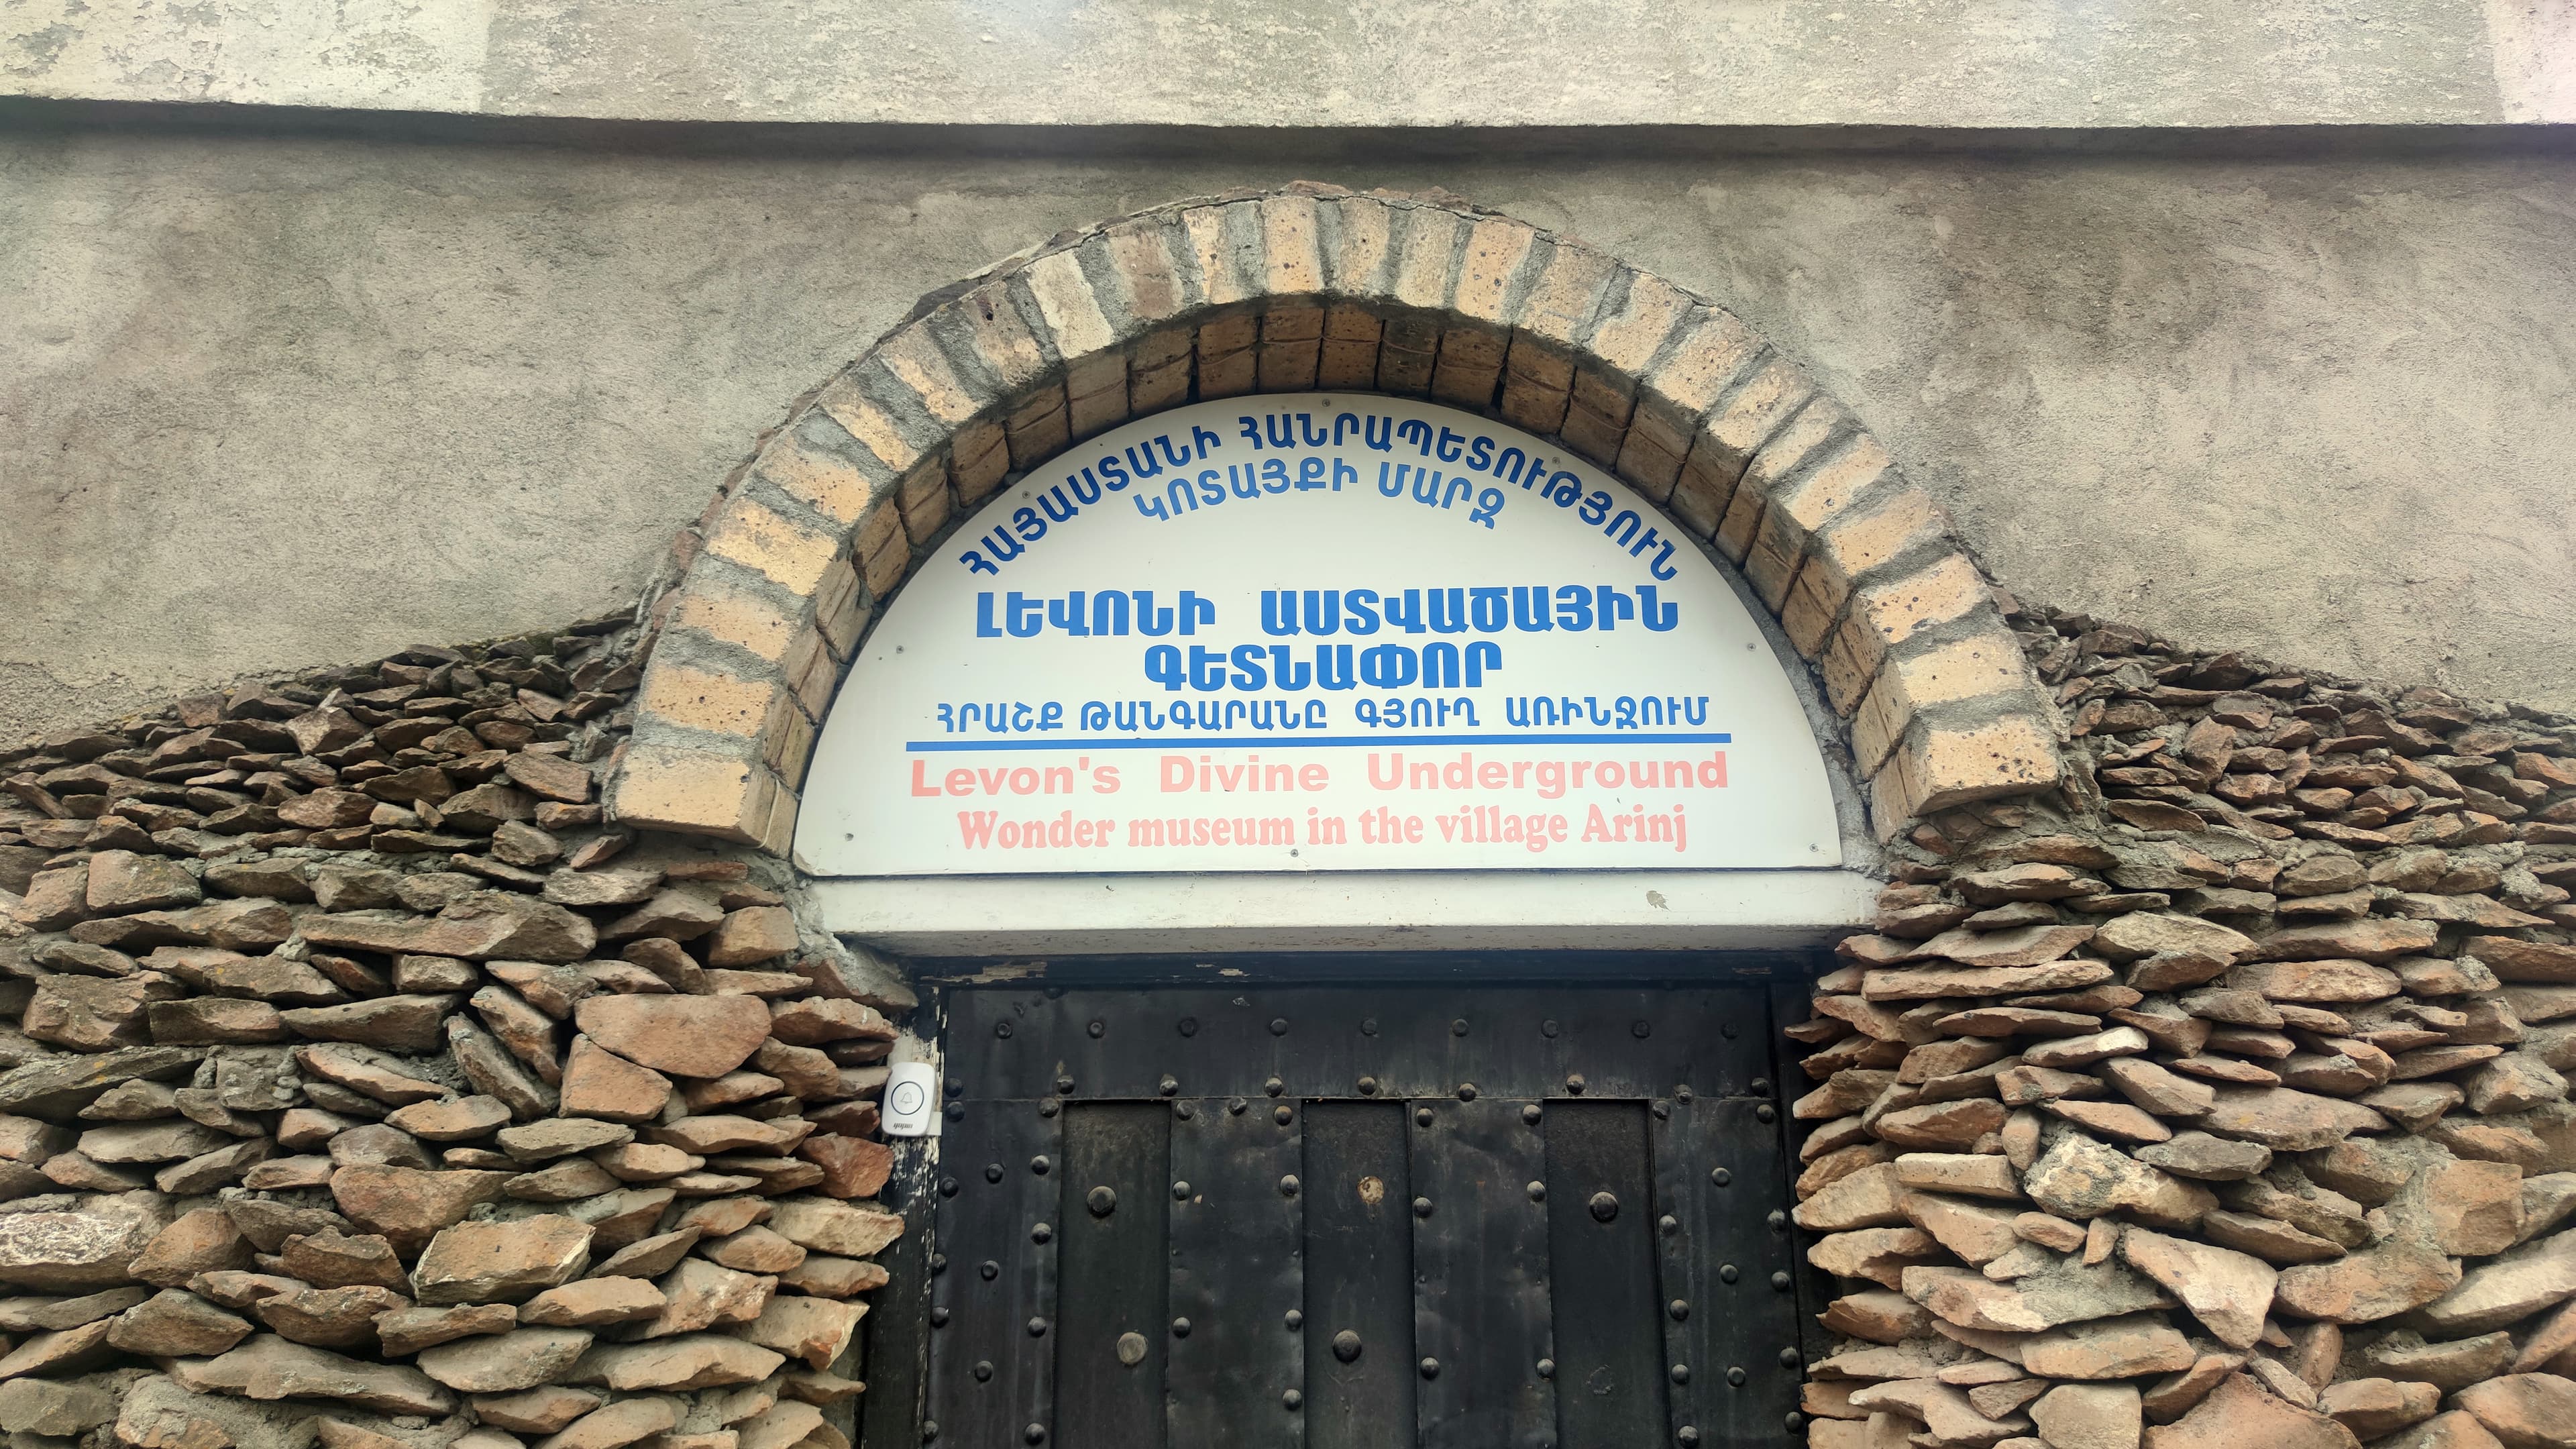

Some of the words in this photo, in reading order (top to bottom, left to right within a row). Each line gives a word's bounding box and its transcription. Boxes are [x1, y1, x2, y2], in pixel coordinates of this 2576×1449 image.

[959, 426, 1221, 576] ՀԱՅԱՍՏԱՆԻ
[1239, 413, 1678, 582] ՀԱՆՐԱՊԵՏՈՒԹՅՈՒՆ
[1133, 456, 1358, 521] ԿՈՏԱՅՔԻ
[1377, 462, 1505, 530] ՄԱՐԶ
[976, 590, 1216, 638] ԼԵՎՈՆԻ
[1260, 584, 1679, 637] ԱՍՏՎԱԾԱՅԻՆ
[1144, 641, 1503, 692] ԳԵՏՆԱՓՈՐ
[937, 701, 1064, 733] ՀՐԱՇՔ
[1080, 699, 1328, 732] ԹԱՆԳԱՐԱՆԸ
[1354, 697, 1481, 729] ԳՅՈՒՂ
[1505, 695, 1710, 730] ԱՌԻՆՋՈՒՄ
[911, 756, 1121, 797] Levon's
[1160, 755, 1330, 793] Divine
[1368, 751, 1729, 799] Underground
[957, 810, 1116, 850] Wonder
[1128, 817, 1295, 847] museum
[1307, 806, 1348, 845] in
[1358, 805, 1424, 845] the
[1435, 804, 1568, 853] village
[1580, 803, 1688, 853] Arinj
